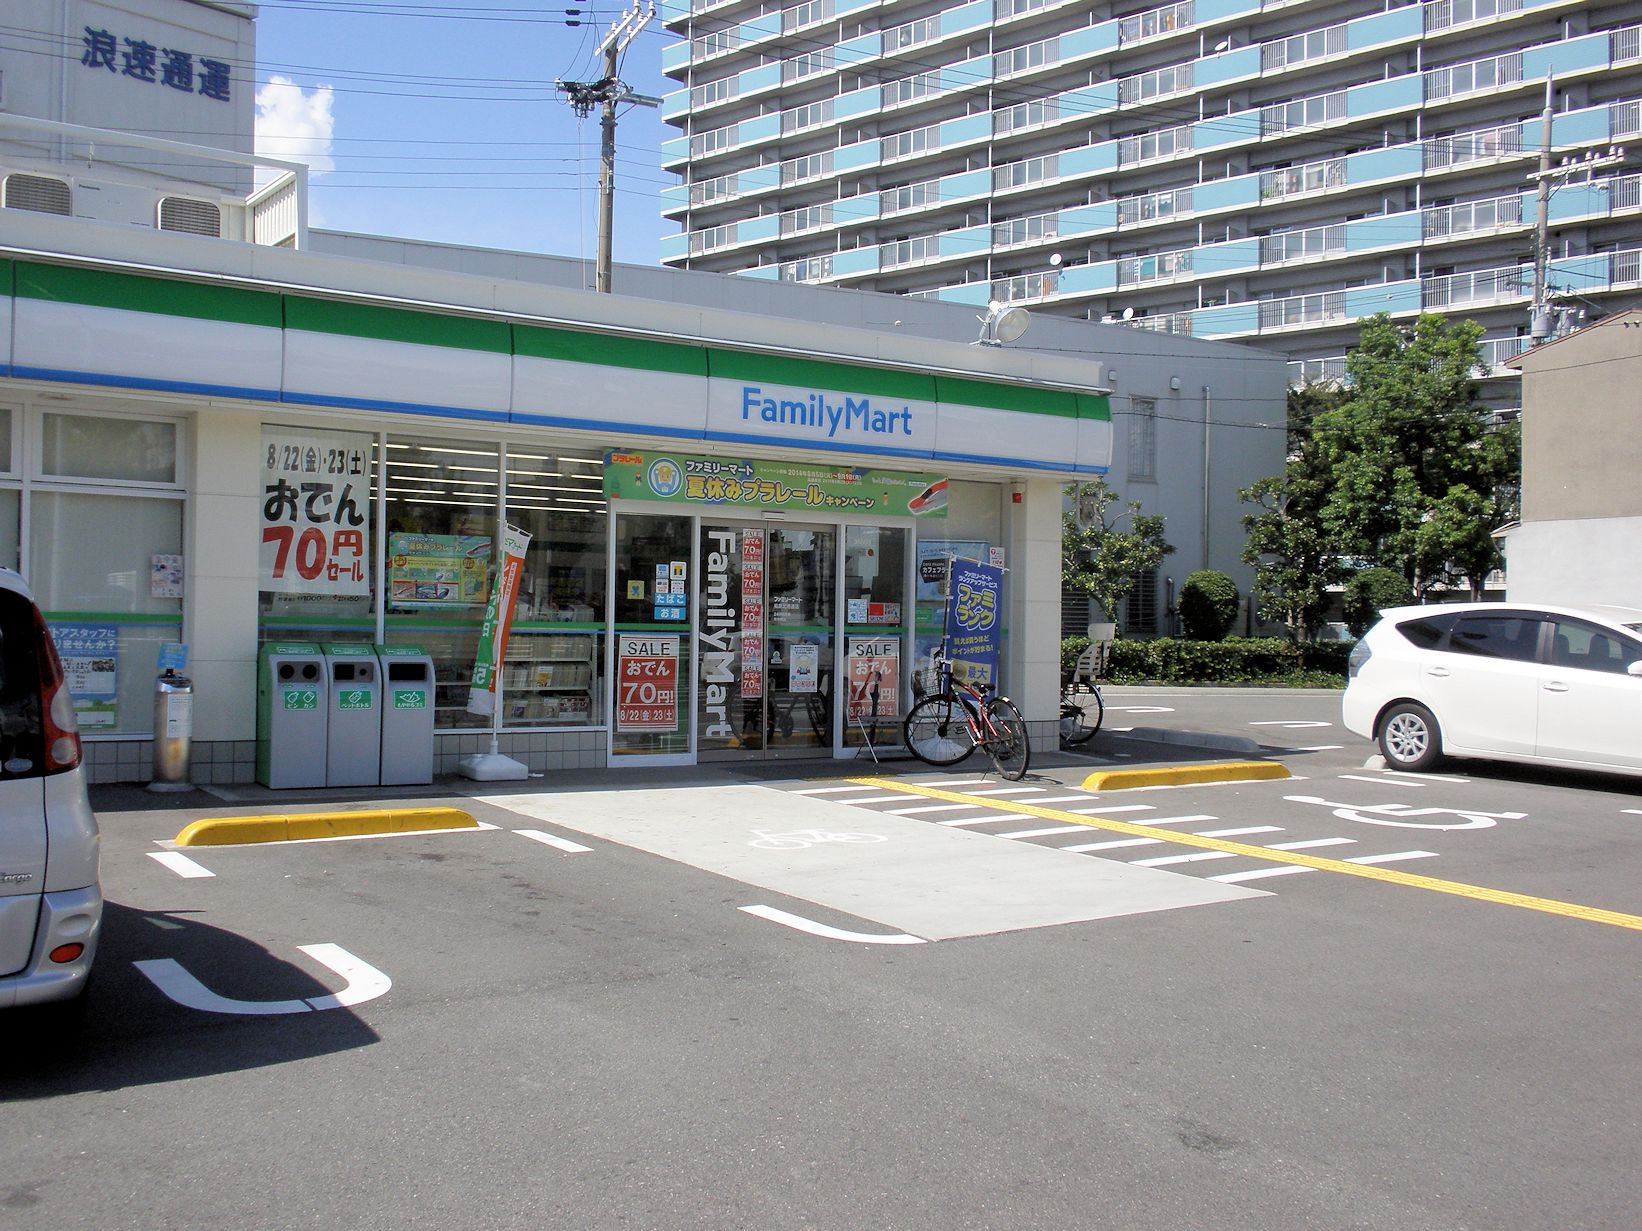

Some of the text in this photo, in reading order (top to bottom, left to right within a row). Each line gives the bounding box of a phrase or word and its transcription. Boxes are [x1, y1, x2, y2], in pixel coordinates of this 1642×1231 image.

[81, 25, 231, 102] 浪速通運
[742, 386, 912, 437] FamilyMart
[685, 460, 754, 476] ファミリーマート
[264, 478, 365, 526] おでん
[685, 475, 824, 506] 夏休みプラレール
[825, 496, 875, 508] キャンペーン
[263, 525, 363, 581] 70円
[327, 558, 364, 582] セール
[964, 570, 992, 582] ファミリーマート
[656, 594, 684, 604] たばこ
[959, 585, 995, 609] ファミ
[660, 608, 680, 619] お酒
[957, 604, 994, 626] ランク
[700, 531, 736, 737] FamilyMart
[627, 641, 670, 656] SALE
[856, 643, 892, 656] SALE
[627, 660, 670, 676] おでん
[855, 660, 892, 675] おでん
[968, 666, 988, 680] 最大
[623, 682, 673, 704] 70円!
